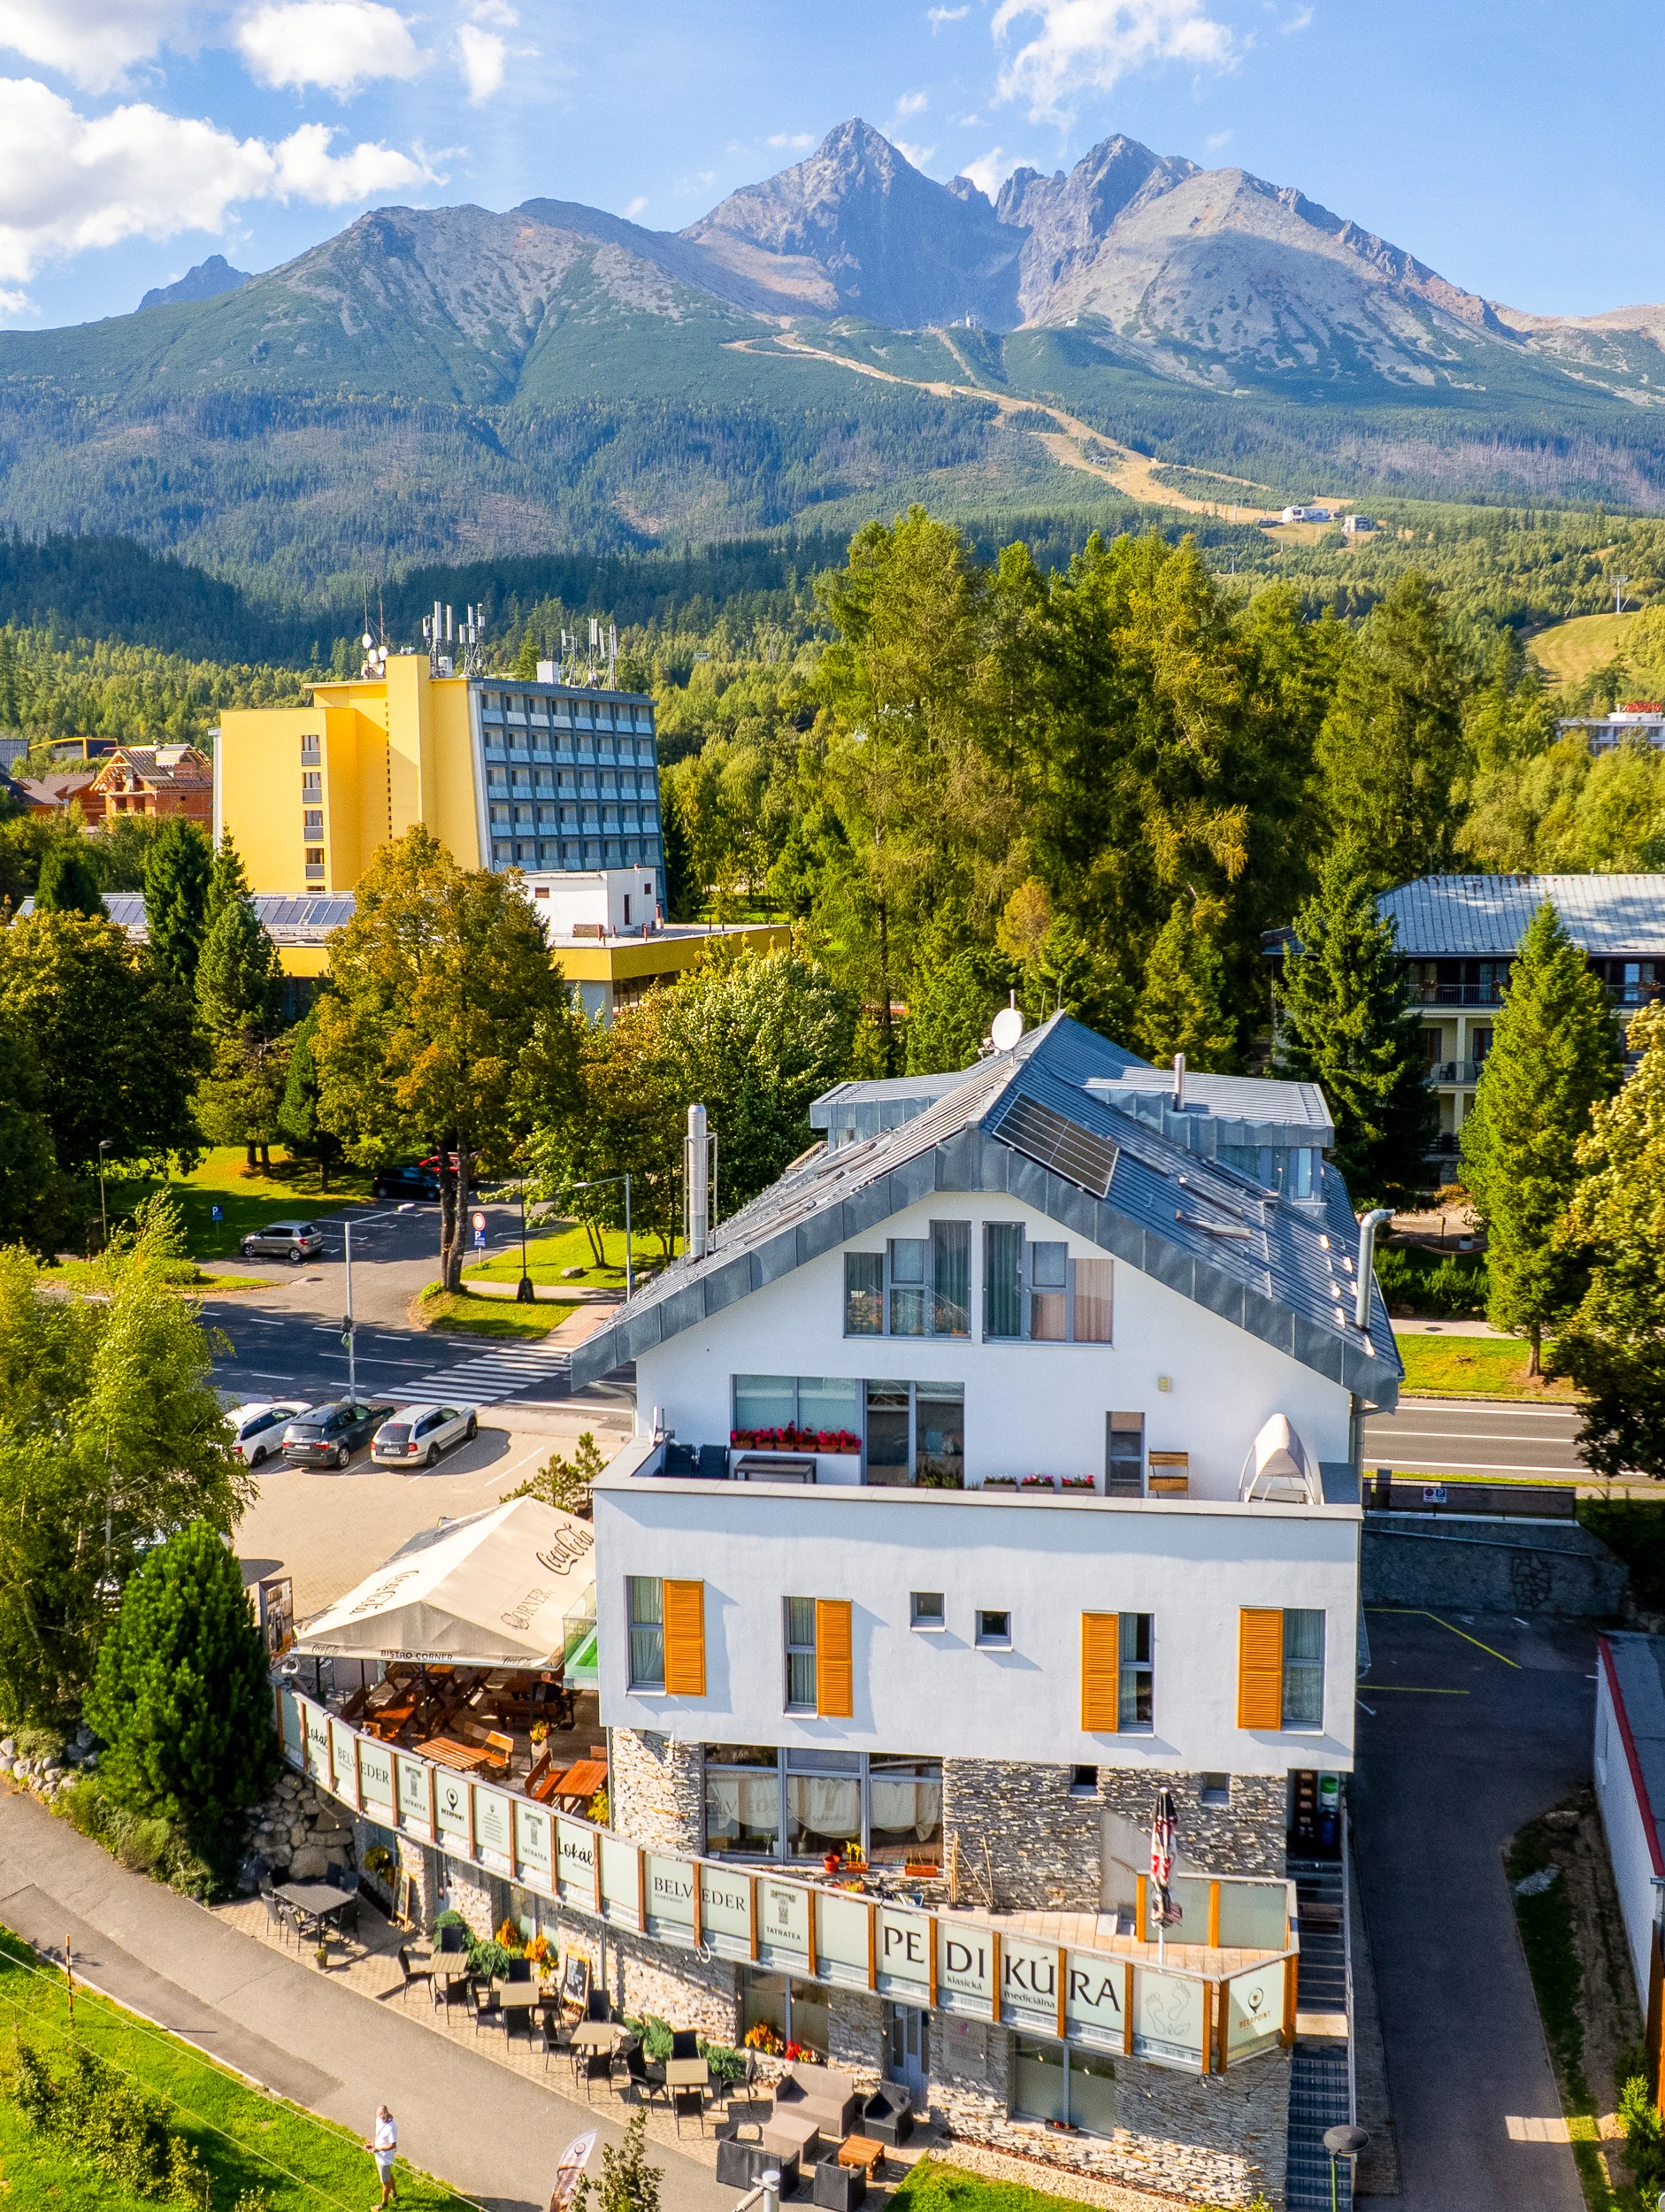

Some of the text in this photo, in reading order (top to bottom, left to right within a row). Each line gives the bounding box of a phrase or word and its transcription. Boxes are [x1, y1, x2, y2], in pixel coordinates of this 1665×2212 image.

[380, 1648, 453, 1662] BISTRO CORNER
[522, 1846, 548, 1863] TATRATEA
[766, 1925, 802, 1941] TATRATEA
[947, 1974, 983, 1992] klasická
